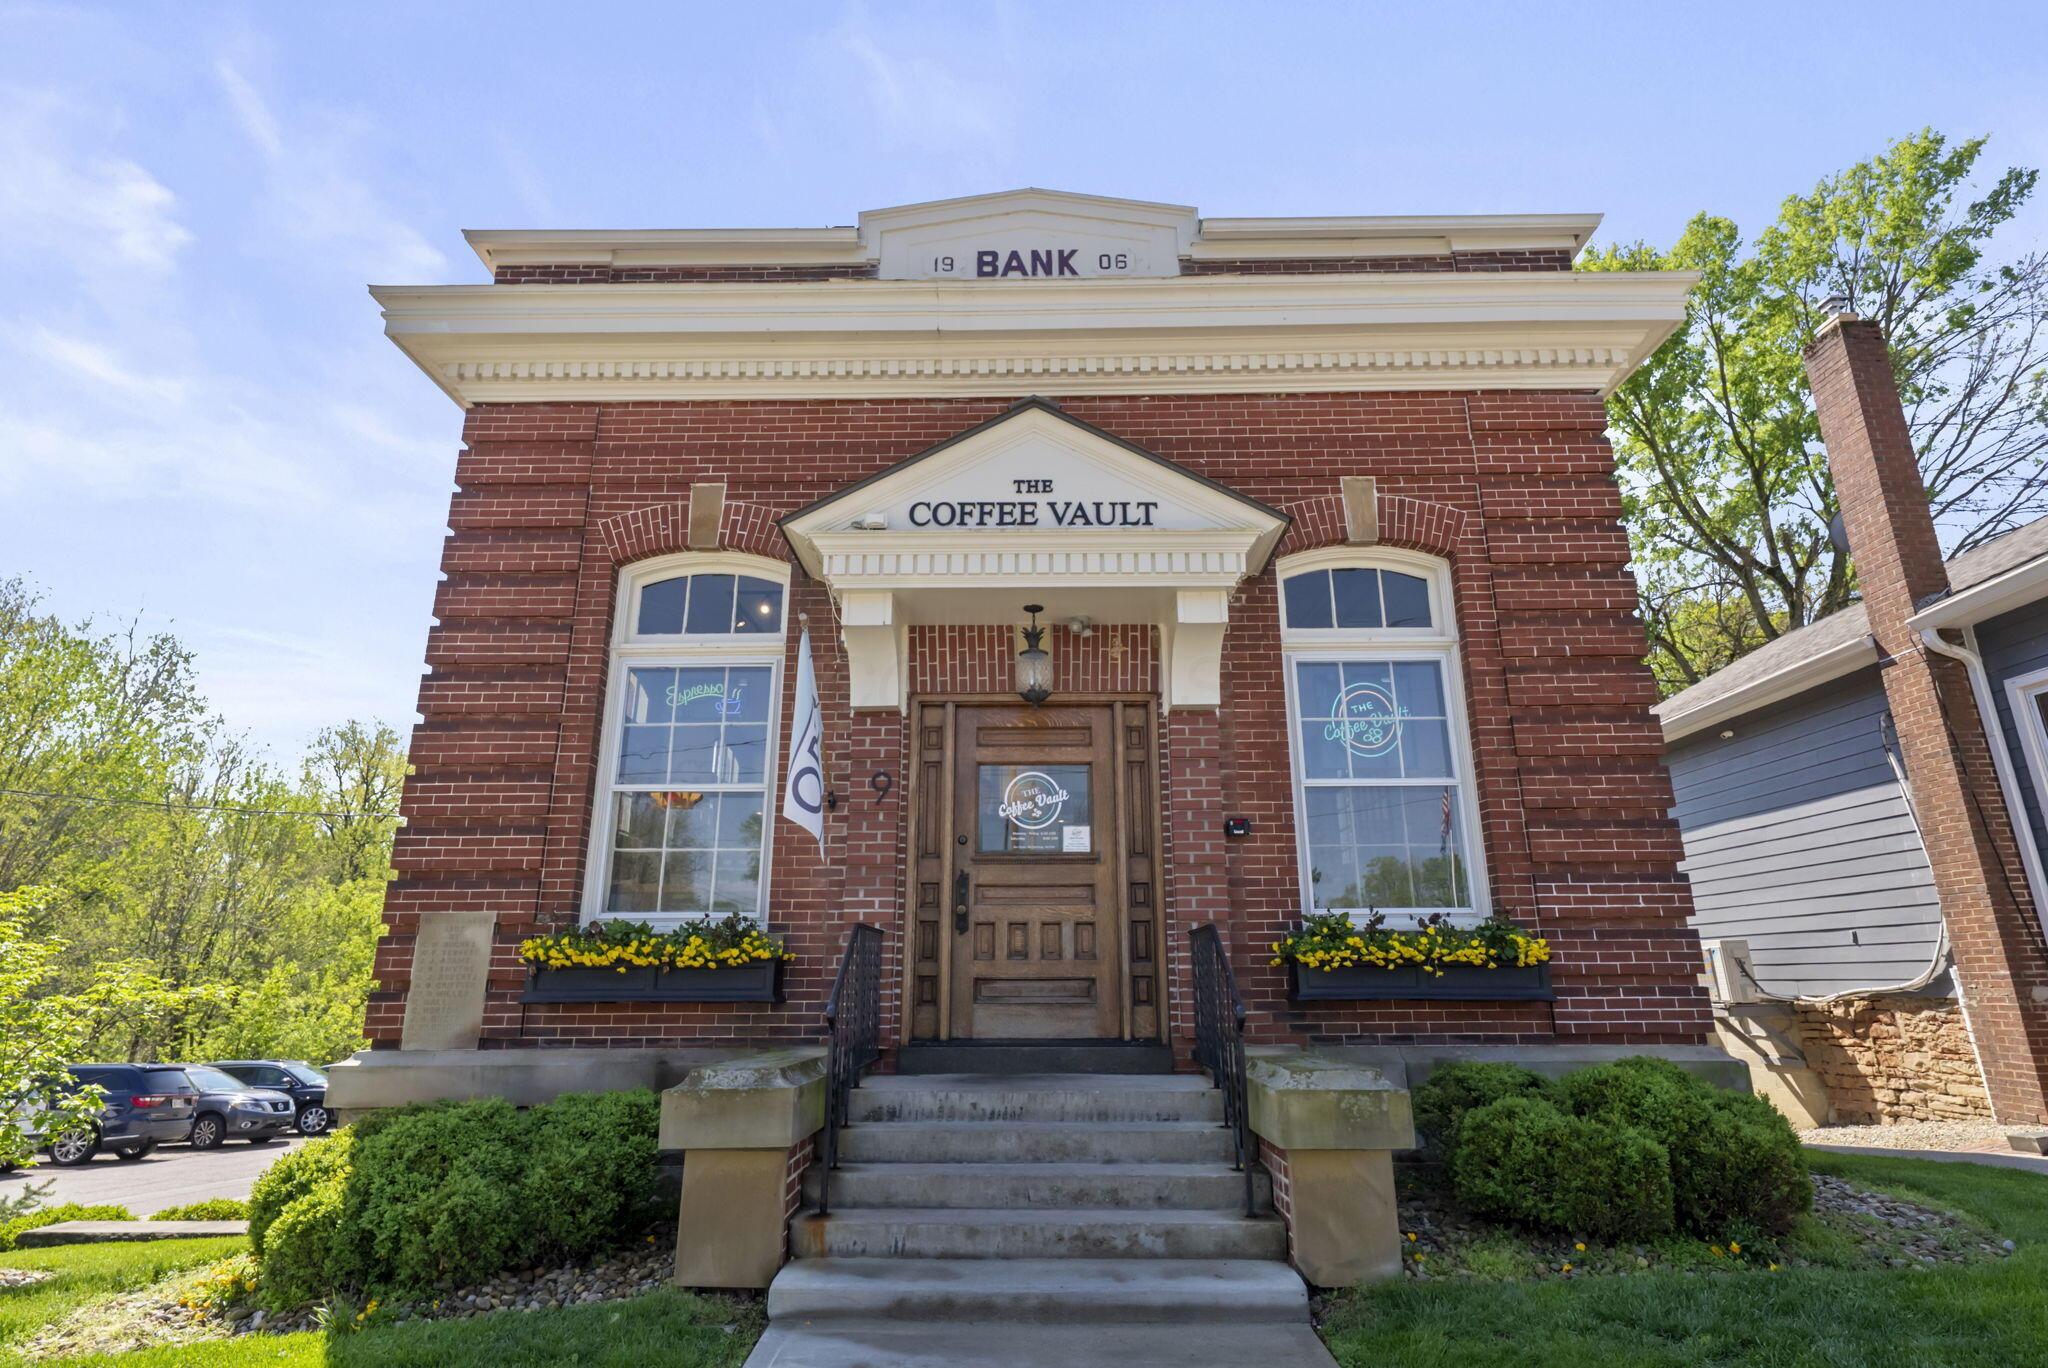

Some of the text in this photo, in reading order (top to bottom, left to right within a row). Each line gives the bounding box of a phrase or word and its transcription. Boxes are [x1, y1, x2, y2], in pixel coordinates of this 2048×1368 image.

[934, 249, 1127, 277] 19 BANK 06
[1013, 479, 1054, 494] THE
[909, 501, 1158, 527] COFFEE VAULT
[666, 683, 724, 706] Espresso
[1350, 701, 1374, 714] THE
[871, 771, 892, 805] 9
[1023, 787, 1041, 798] THE
[998, 789, 1070, 817] Coffee Vault
